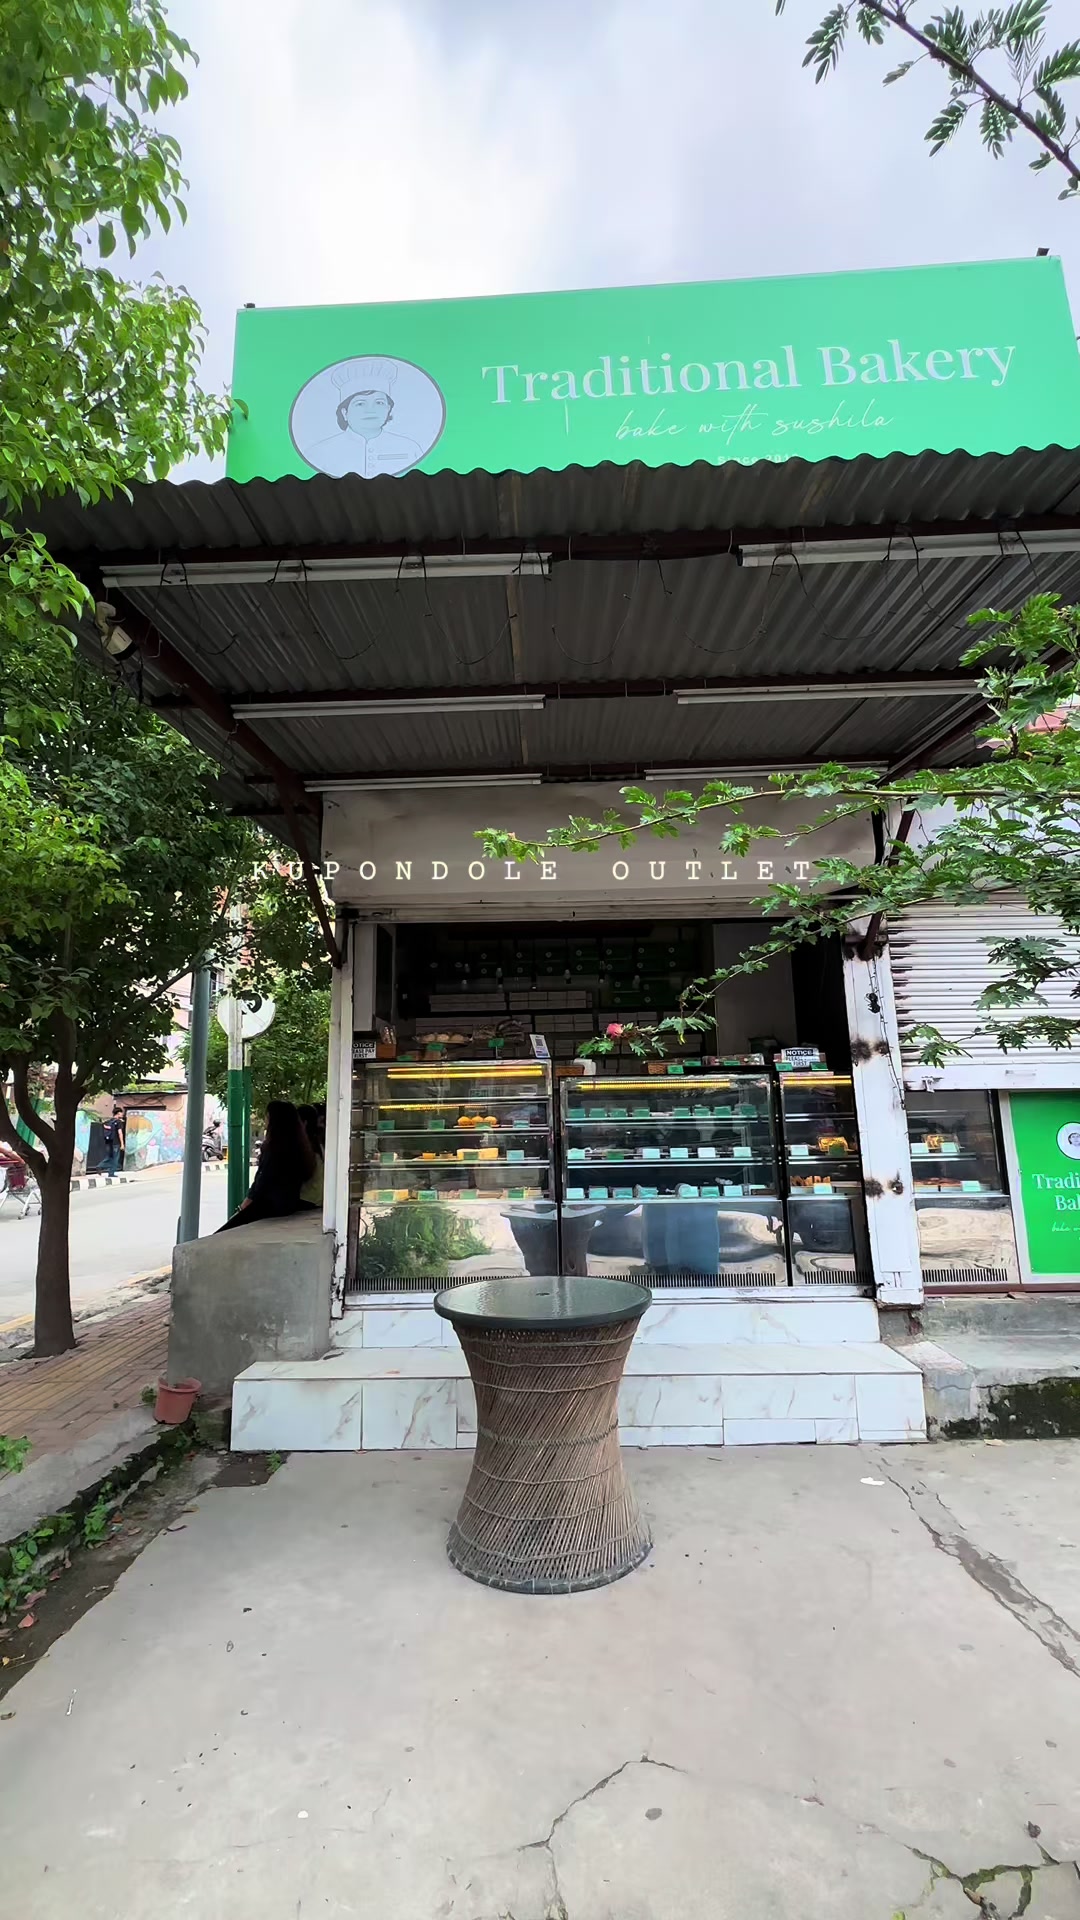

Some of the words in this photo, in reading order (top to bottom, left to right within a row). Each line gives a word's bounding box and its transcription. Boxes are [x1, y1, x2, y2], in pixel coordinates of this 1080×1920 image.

[481, 345, 803, 404] Traditional
[816, 338, 1017, 388] Bakery
[615, 408, 687, 441] bake
[698, 403, 769, 446] with
[771, 398, 895, 436] sushila
[765, 453, 800, 464] 201
